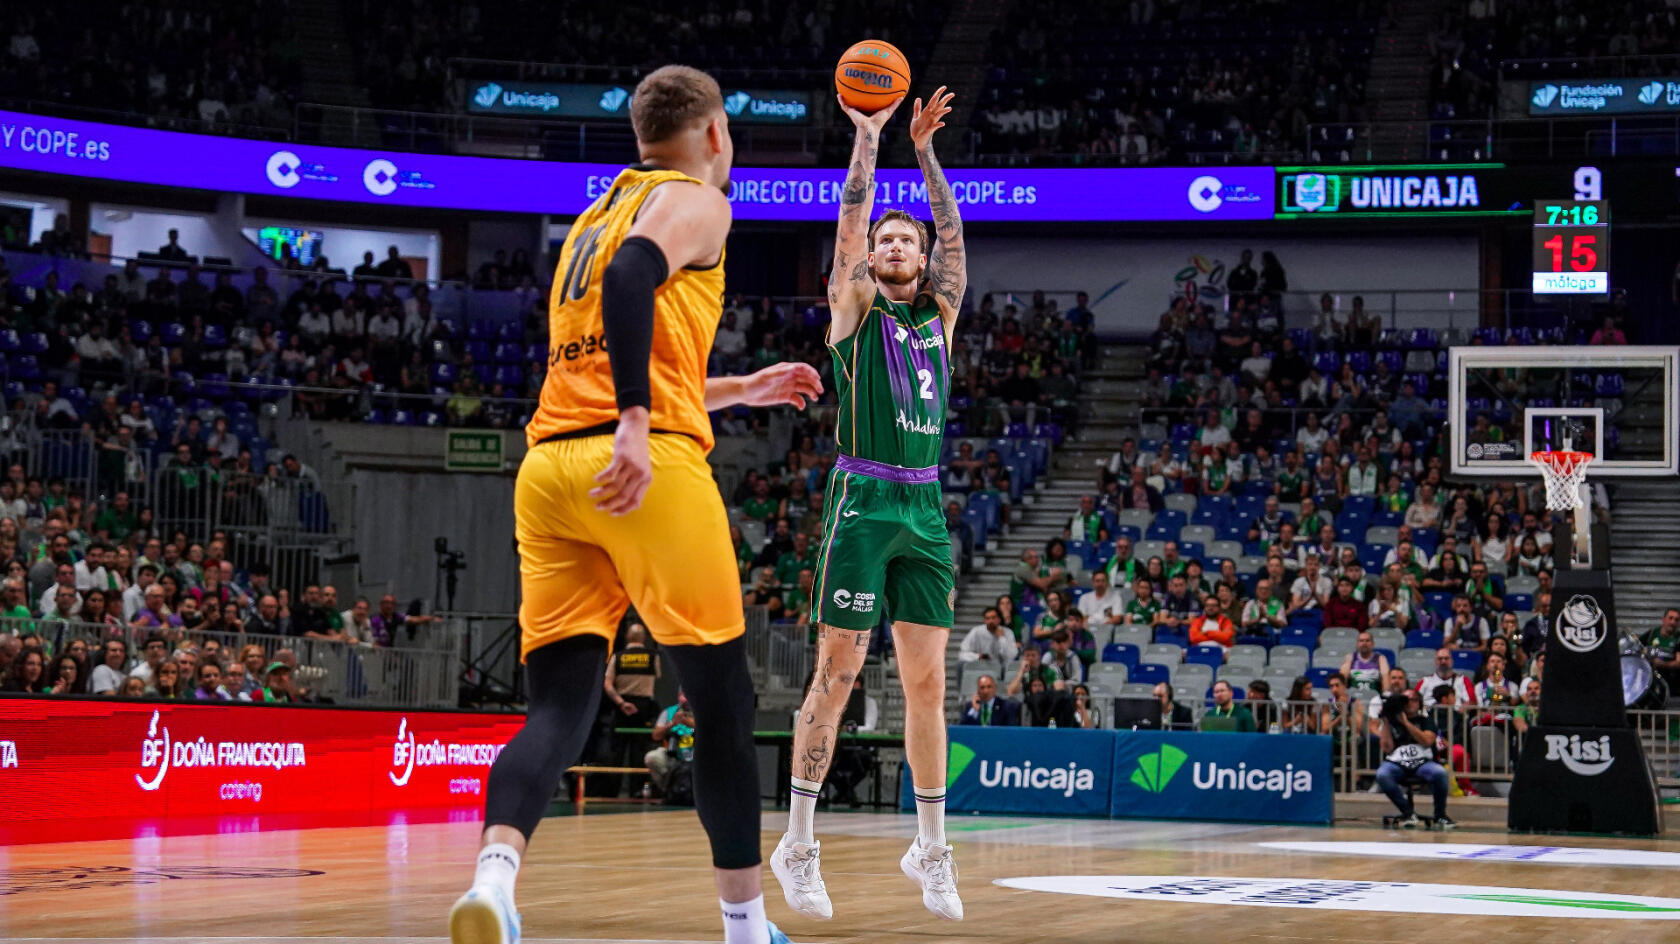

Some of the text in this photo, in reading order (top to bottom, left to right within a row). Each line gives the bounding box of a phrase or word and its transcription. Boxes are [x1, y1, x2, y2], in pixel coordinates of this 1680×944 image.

[845, 66, 893, 89] Wilson
[1560, 84, 1623, 97] Fundación
[503, 91, 560, 112] Unicaja
[750, 98, 806, 119] Unicaja
[1560, 95, 1606, 110] Unicaja
[1, 123, 110, 161] Y COPE.es
[898, 180, 928, 205] FM
[952, 180, 1037, 205] COPE.es
[1350, 175, 1480, 208] UNICAJA
[1574, 166, 1602, 201] 9
[1545, 204, 1599, 226] 7:16
[1544, 234, 1598, 273] 15
[917, 368, 934, 400] 2
[1564, 626, 1598, 645] Risi
[172, 736, 215, 767] DOÑA
[217, 742, 306, 770] FRANCISQUITA
[416, 738, 447, 766] DOÑA
[1544, 734, 1614, 775] Risi
[979, 760, 1095, 798] Unicaja
[1192, 761, 1313, 799] Unicaja
